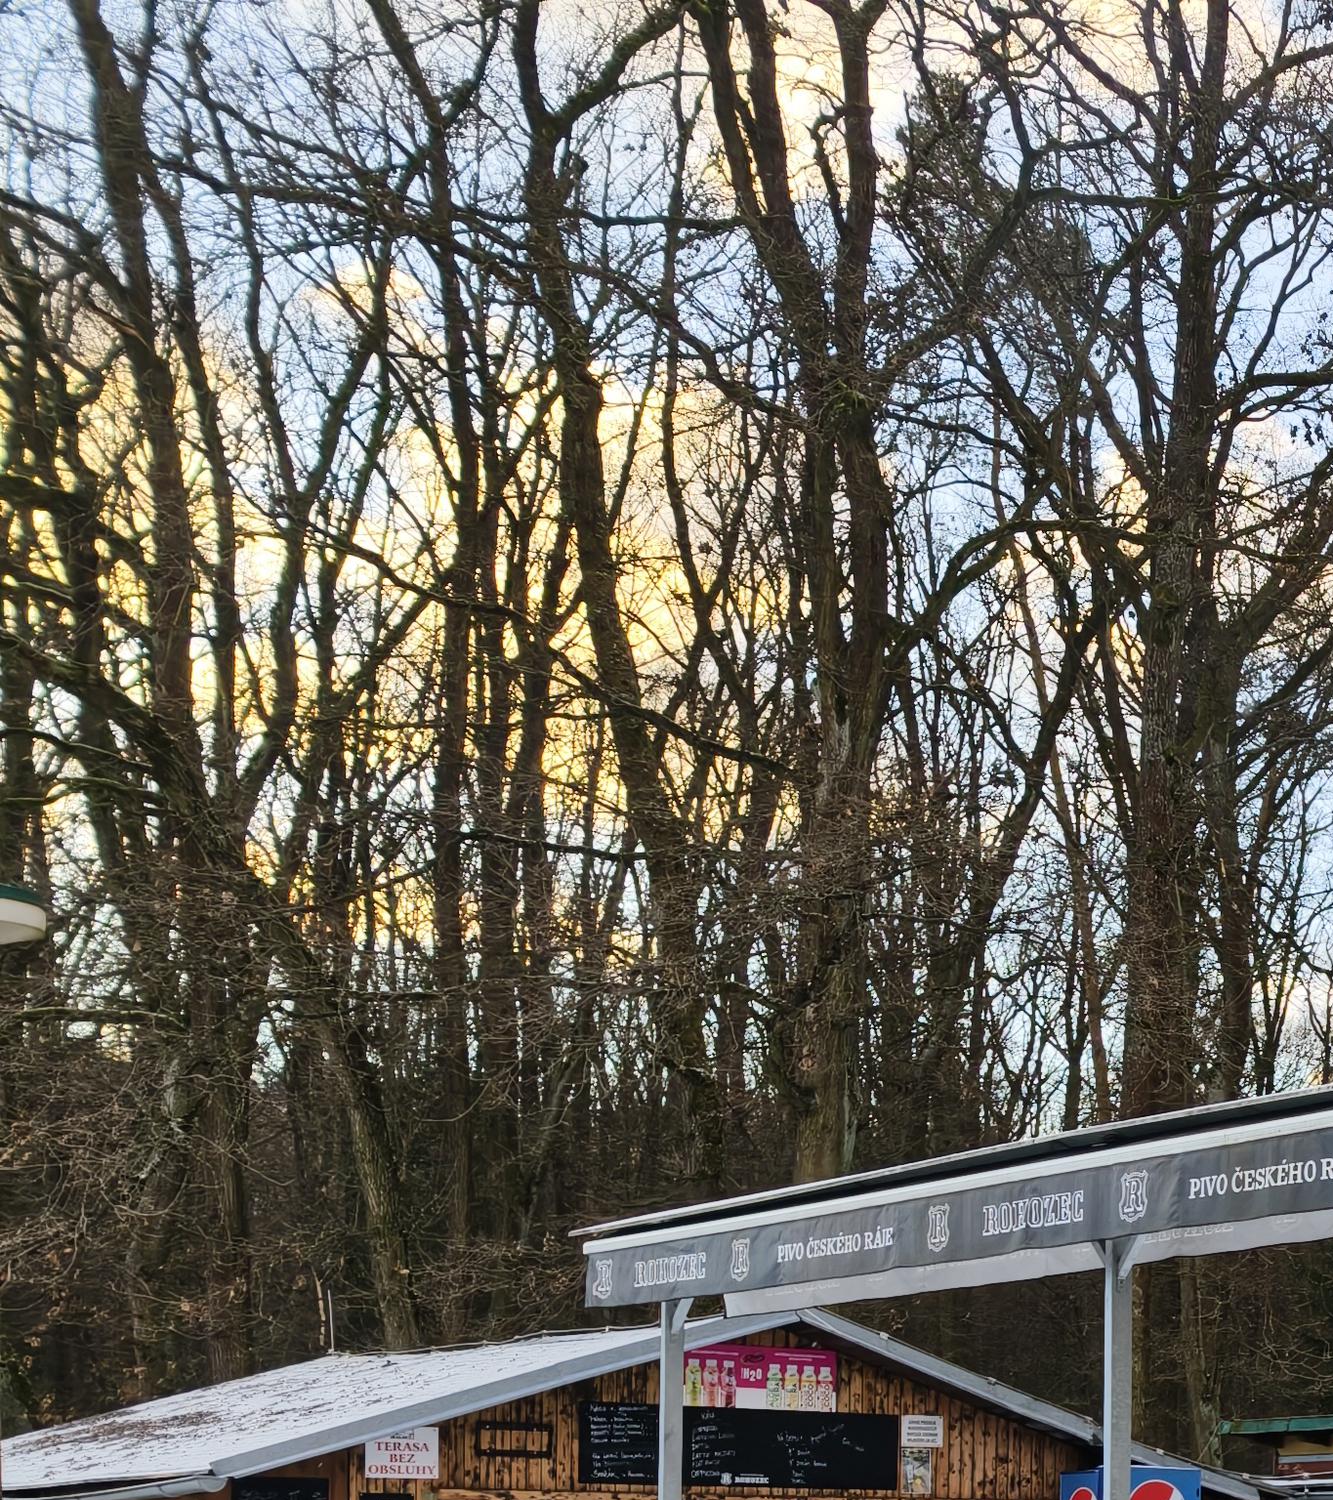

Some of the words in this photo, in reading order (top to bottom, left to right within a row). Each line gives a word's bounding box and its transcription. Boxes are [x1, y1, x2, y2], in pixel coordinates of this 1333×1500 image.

[634, 1252, 706, 1288] ROHOZEC
[777, 1242, 803, 1264] PIVO
[806, 1231, 861, 1259] ČESKÉHO
[864, 1225, 894, 1251] RÁJE
[981, 1189, 1084, 1237] ROHOZEC
[1188, 1173, 1228, 1200] PIVO
[1231, 1158, 1317, 1194] ČESKÉHO
[375, 1441, 430, 1452] TERASA
[389, 1453, 416, 1464] BEZ
[368, 1464, 436, 1475] OBSLUHY
